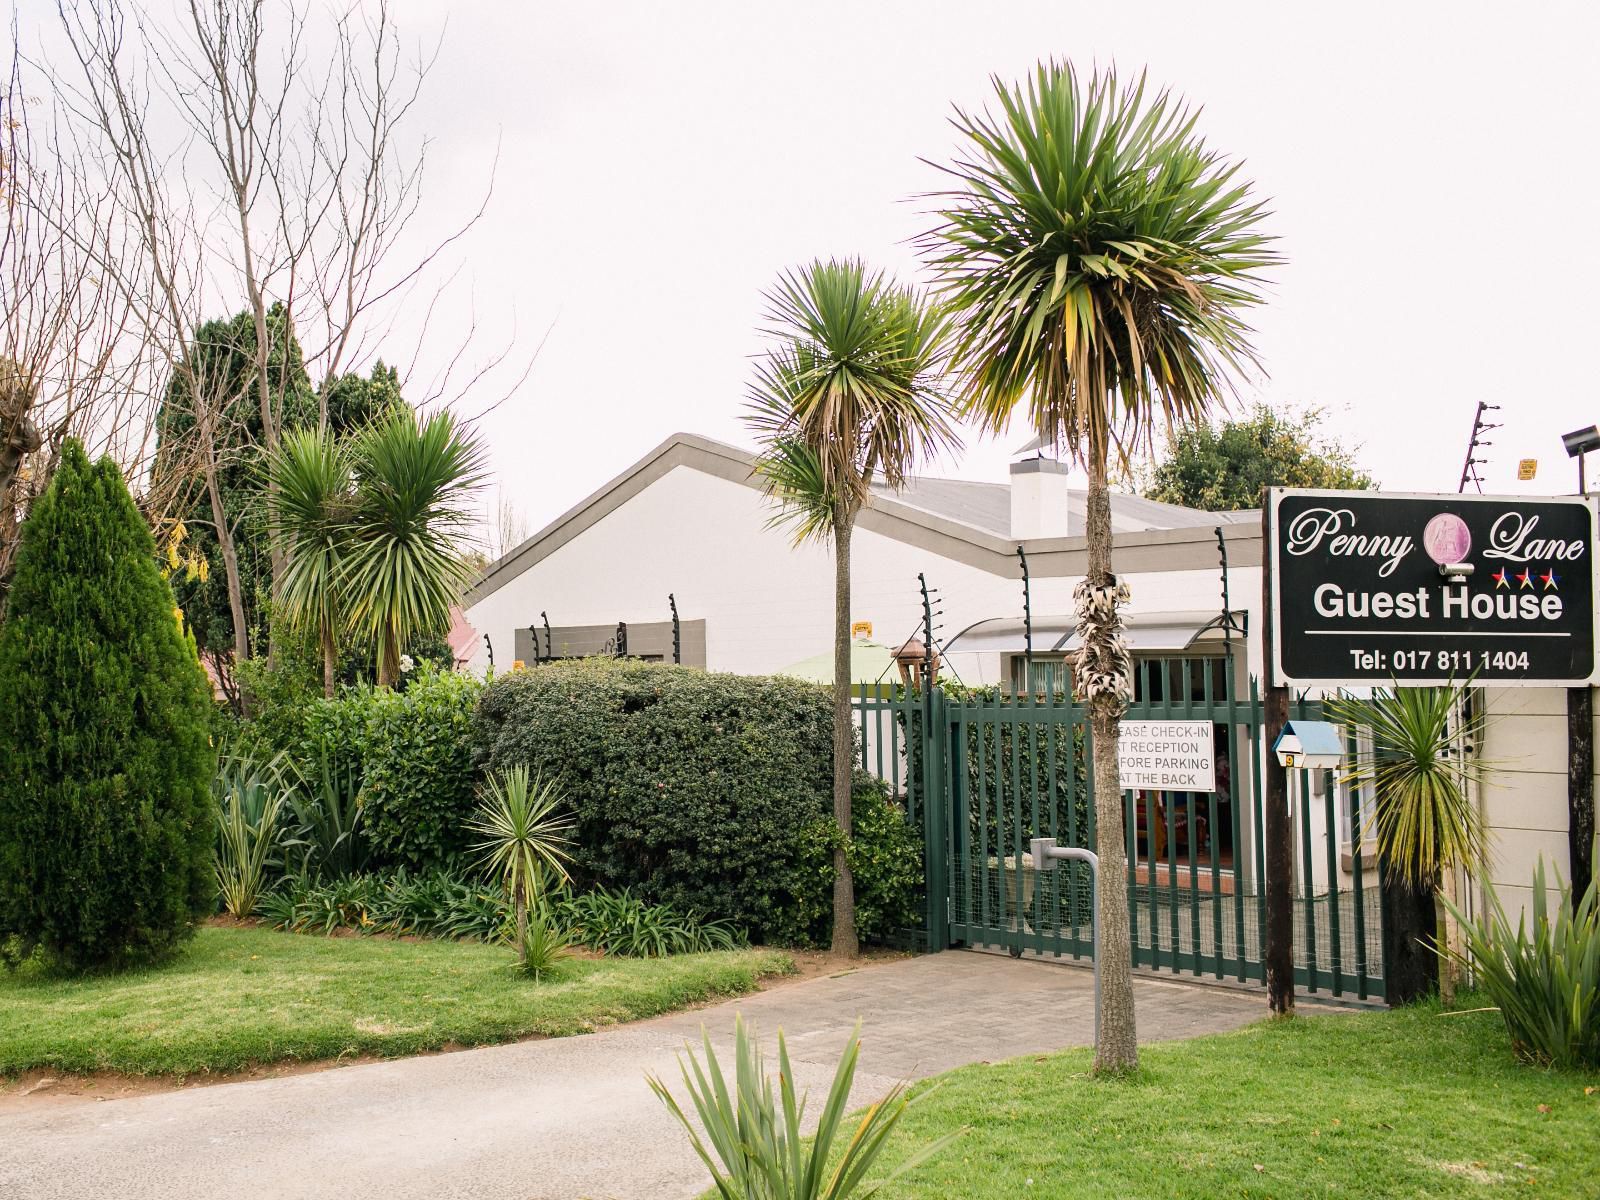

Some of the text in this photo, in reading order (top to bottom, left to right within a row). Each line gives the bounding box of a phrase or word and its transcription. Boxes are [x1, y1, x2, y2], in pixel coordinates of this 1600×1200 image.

[1287, 507, 1584, 577] Penny Lane
[1313, 583, 1563, 620] Guest House
[1350, 649, 1530, 670] Tel: 017 811 1404
[1118, 726, 1209, 738] EASE CHECK-IN
[1130, 742, 1199, 753] RECEPTION
[1120, 757, 1209, 769] FORE PARKING
[1286, 755, 1294, 767] 9
[1135, 773, 1158, 784] THE
[1162, 774, 1197, 785] BACK
